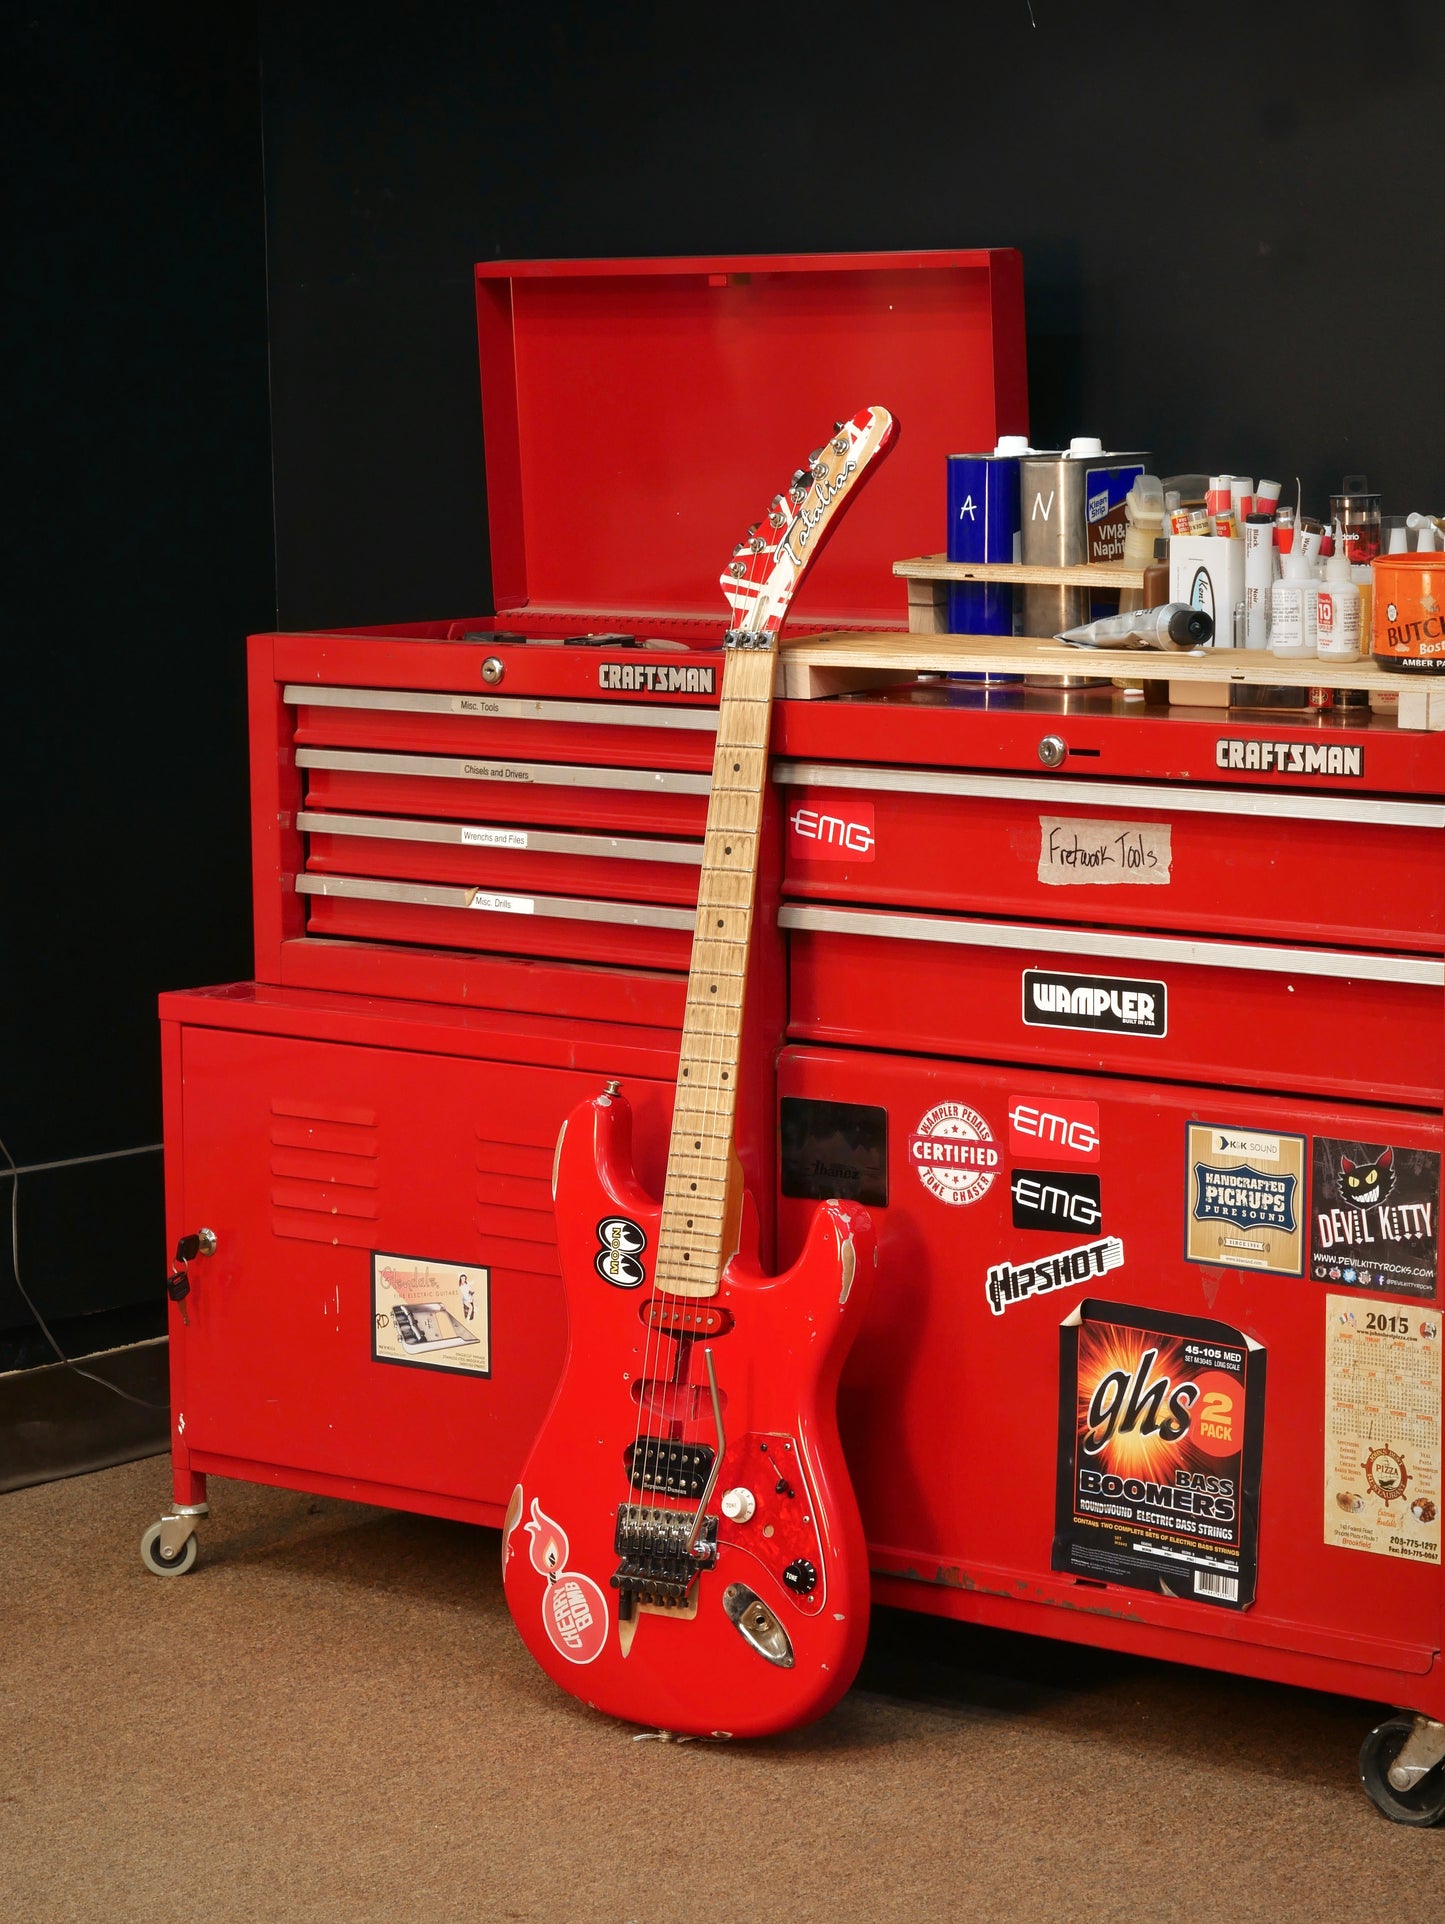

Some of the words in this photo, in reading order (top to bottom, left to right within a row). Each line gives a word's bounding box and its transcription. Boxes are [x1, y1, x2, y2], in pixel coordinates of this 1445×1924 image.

[773, 460, 856, 566] Tatalias
[960, 494, 977, 521] A
[1032, 490, 1054, 522] N
[1090, 496, 1107, 510] Klean
[1091, 506, 1106, 518] Strip
[1099, 523, 1130, 540] VM&
[1199, 578, 1208, 604] Kent
[1318, 604, 1331, 620] 10
[1402, 659, 1433, 667] AMBER
[598, 664, 714, 693] CRAFTSMAN
[461, 700, 479, 711] Misc.
[481, 702, 499, 712] Tools
[1216, 740, 1362, 776] CRAFTSMAN
[464, 765, 489, 776] Chisels
[491, 769, 504, 777] and
[505, 769, 529, 780] Drivers
[464, 831, 493, 842] Wrenchs
[494, 834, 507, 843] and
[508, 835, 525, 844] Files
[790, 808, 874, 852] EMG
[1050, 827, 1115, 868] Fretwork
[1115, 832, 1158, 868] Tools
[476, 896, 492, 906] Misc.
[495, 898, 512, 908] Drills
[1032, 982, 1155, 1021] WAMPLER
[920, 1106, 959, 1134] WAMPLER
[962, 1108, 990, 1140] PEDALS
[1008, 1104, 1100, 1152] EMG
[912, 1141, 999, 1166] CERTIFIED
[1250, 1143, 1278, 1154] SOUND
[922, 1169, 944, 1196] TONE
[952, 1176, 989, 1202] CHASER
[1205, 1172, 1286, 1193] HANDCRAFTED
[1011, 1178, 1102, 1226] EMG
[1205, 1186, 1286, 1212] PICKUPS
[1205, 1205, 1237, 1216] PURE
[1242, 1211, 1285, 1222] SOUND
[1318, 1208, 1374, 1248] DEVIL
[1378, 1202, 1432, 1242] KITTY
[610, 1227, 621, 1274] MOON
[989, 1243, 1108, 1312] HIPSHOT
[1313, 1253, 1434, 1278] WWW.DEVILKITTYROCKS.COM
[1366, 1312, 1409, 1334] 2015
[1185, 1345, 1222, 1359] 45-105
[1224, 1351, 1241, 1362] MED
[1185, 1355, 1193, 1363] SET
[1083, 1348, 1200, 1456] ghs
[1200, 1392, 1233, 1425] 2
[1200, 1423, 1232, 1442] PACK
[1376, 1464, 1399, 1476] PIZZA
[643, 1482, 667, 1491] Seymour
[667, 1486, 687, 1495] Duncan
[1079, 1469, 1235, 1522] BOOMERS
[1175, 1470, 1233, 1497] BASS
[1080, 1499, 1132, 1518] ROUNDWOUND
[1137, 1510, 1174, 1528] ELECTRIC
[1175, 1519, 1196, 1532] BASS
[1198, 1525, 1232, 1540] STRINGS
[1100, 1522, 1113, 1530] TWO
[1114, 1524, 1144, 1537] COMPLETE
[1145, 1530, 1160, 1540] SETS
[1169, 1535, 1197, 1548] ELECTRIC
[1197, 1542, 1213, 1551] BASS
[1214, 1545, 1240, 1557] STRINGS
[1342, 1538, 1372, 1549] Brookfield
[1390, 1536, 1438, 1551] 203-775-1297
[786, 1572, 798, 1582] TONE
[553, 1586, 583, 1648] CHERRY
[565, 1582, 593, 1632] BOMB
